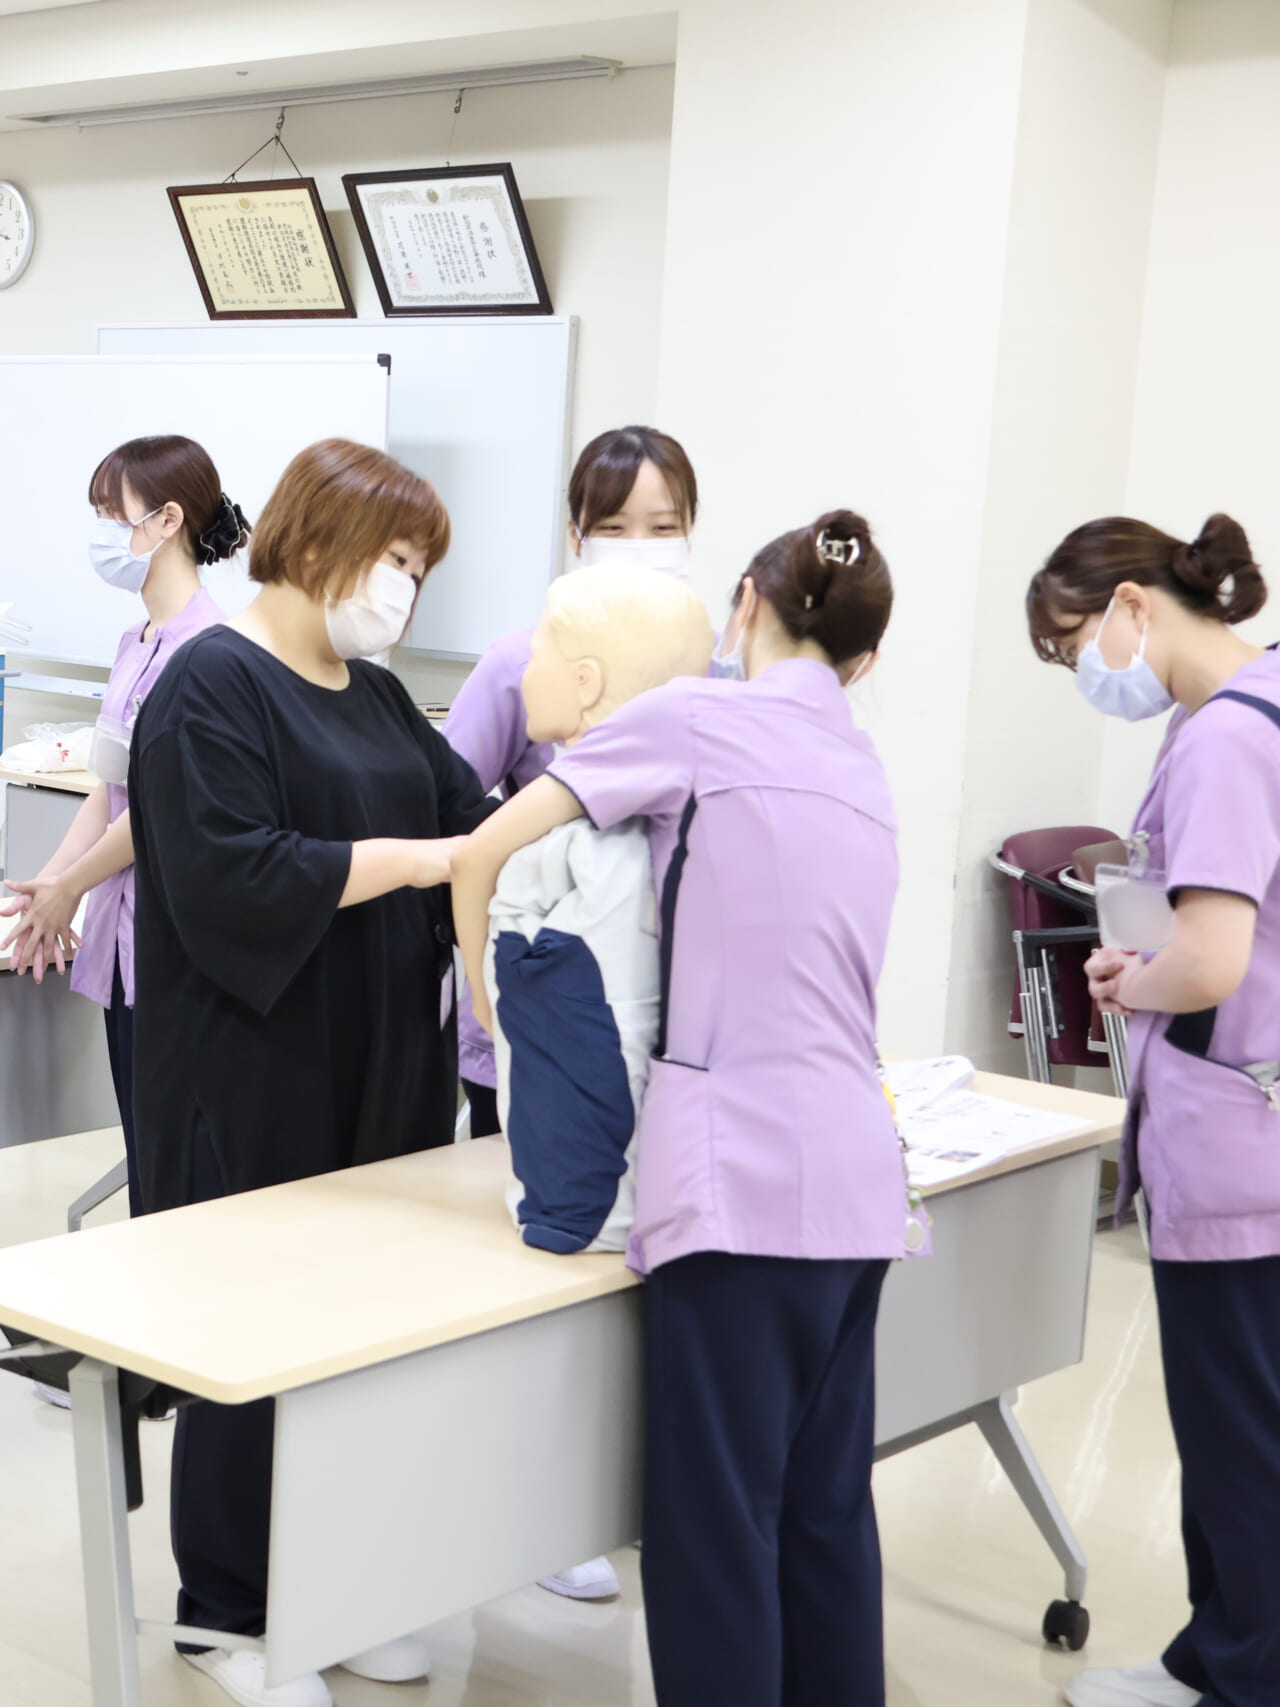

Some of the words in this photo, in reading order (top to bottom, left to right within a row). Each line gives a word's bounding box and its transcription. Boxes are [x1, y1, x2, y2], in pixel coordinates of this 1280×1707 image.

[9, 198, 12, 210] 1
[15, 210, 22, 223] 2
[18, 228, 24, 240] 3
[479, 221, 497, 259] 感謝状
[296, 228, 315, 268] 感謝状
[5, 259, 11, 271] 5
